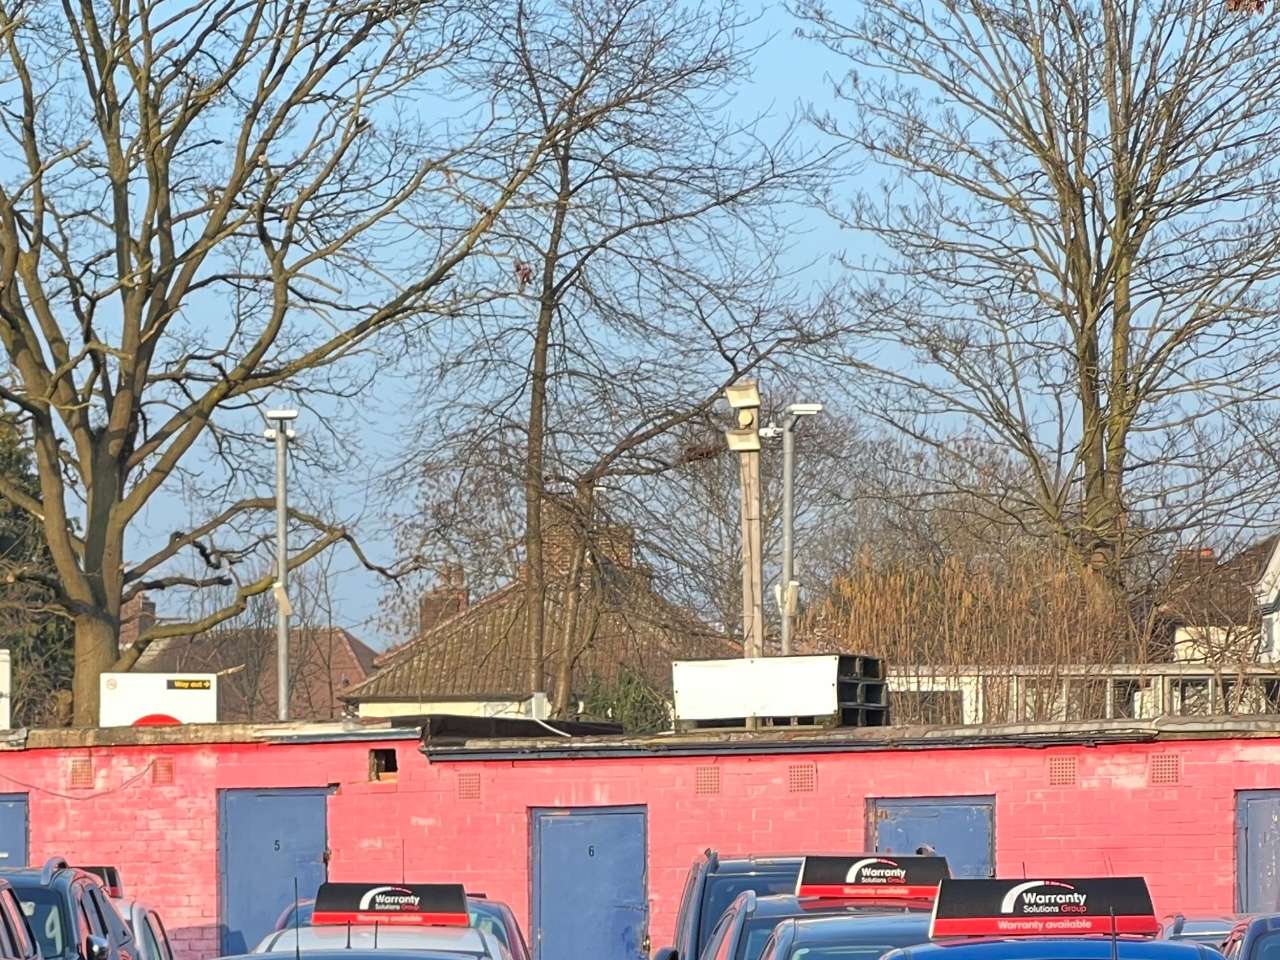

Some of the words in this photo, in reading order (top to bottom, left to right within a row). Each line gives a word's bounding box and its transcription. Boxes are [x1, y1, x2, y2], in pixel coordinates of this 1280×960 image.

[274, 839, 281, 852] 5
[588, 845, 595, 857] 6
[861, 867, 907, 879] Warranty
[375, 894, 421, 906] Warranty
[1022, 891, 1088, 906] Warranty
[1023, 904, 1060, 914] Solutions
[1060, 904, 1088, 915] Group
[998, 919, 1044, 932] Warranty
[1045, 918, 1093, 929] available
